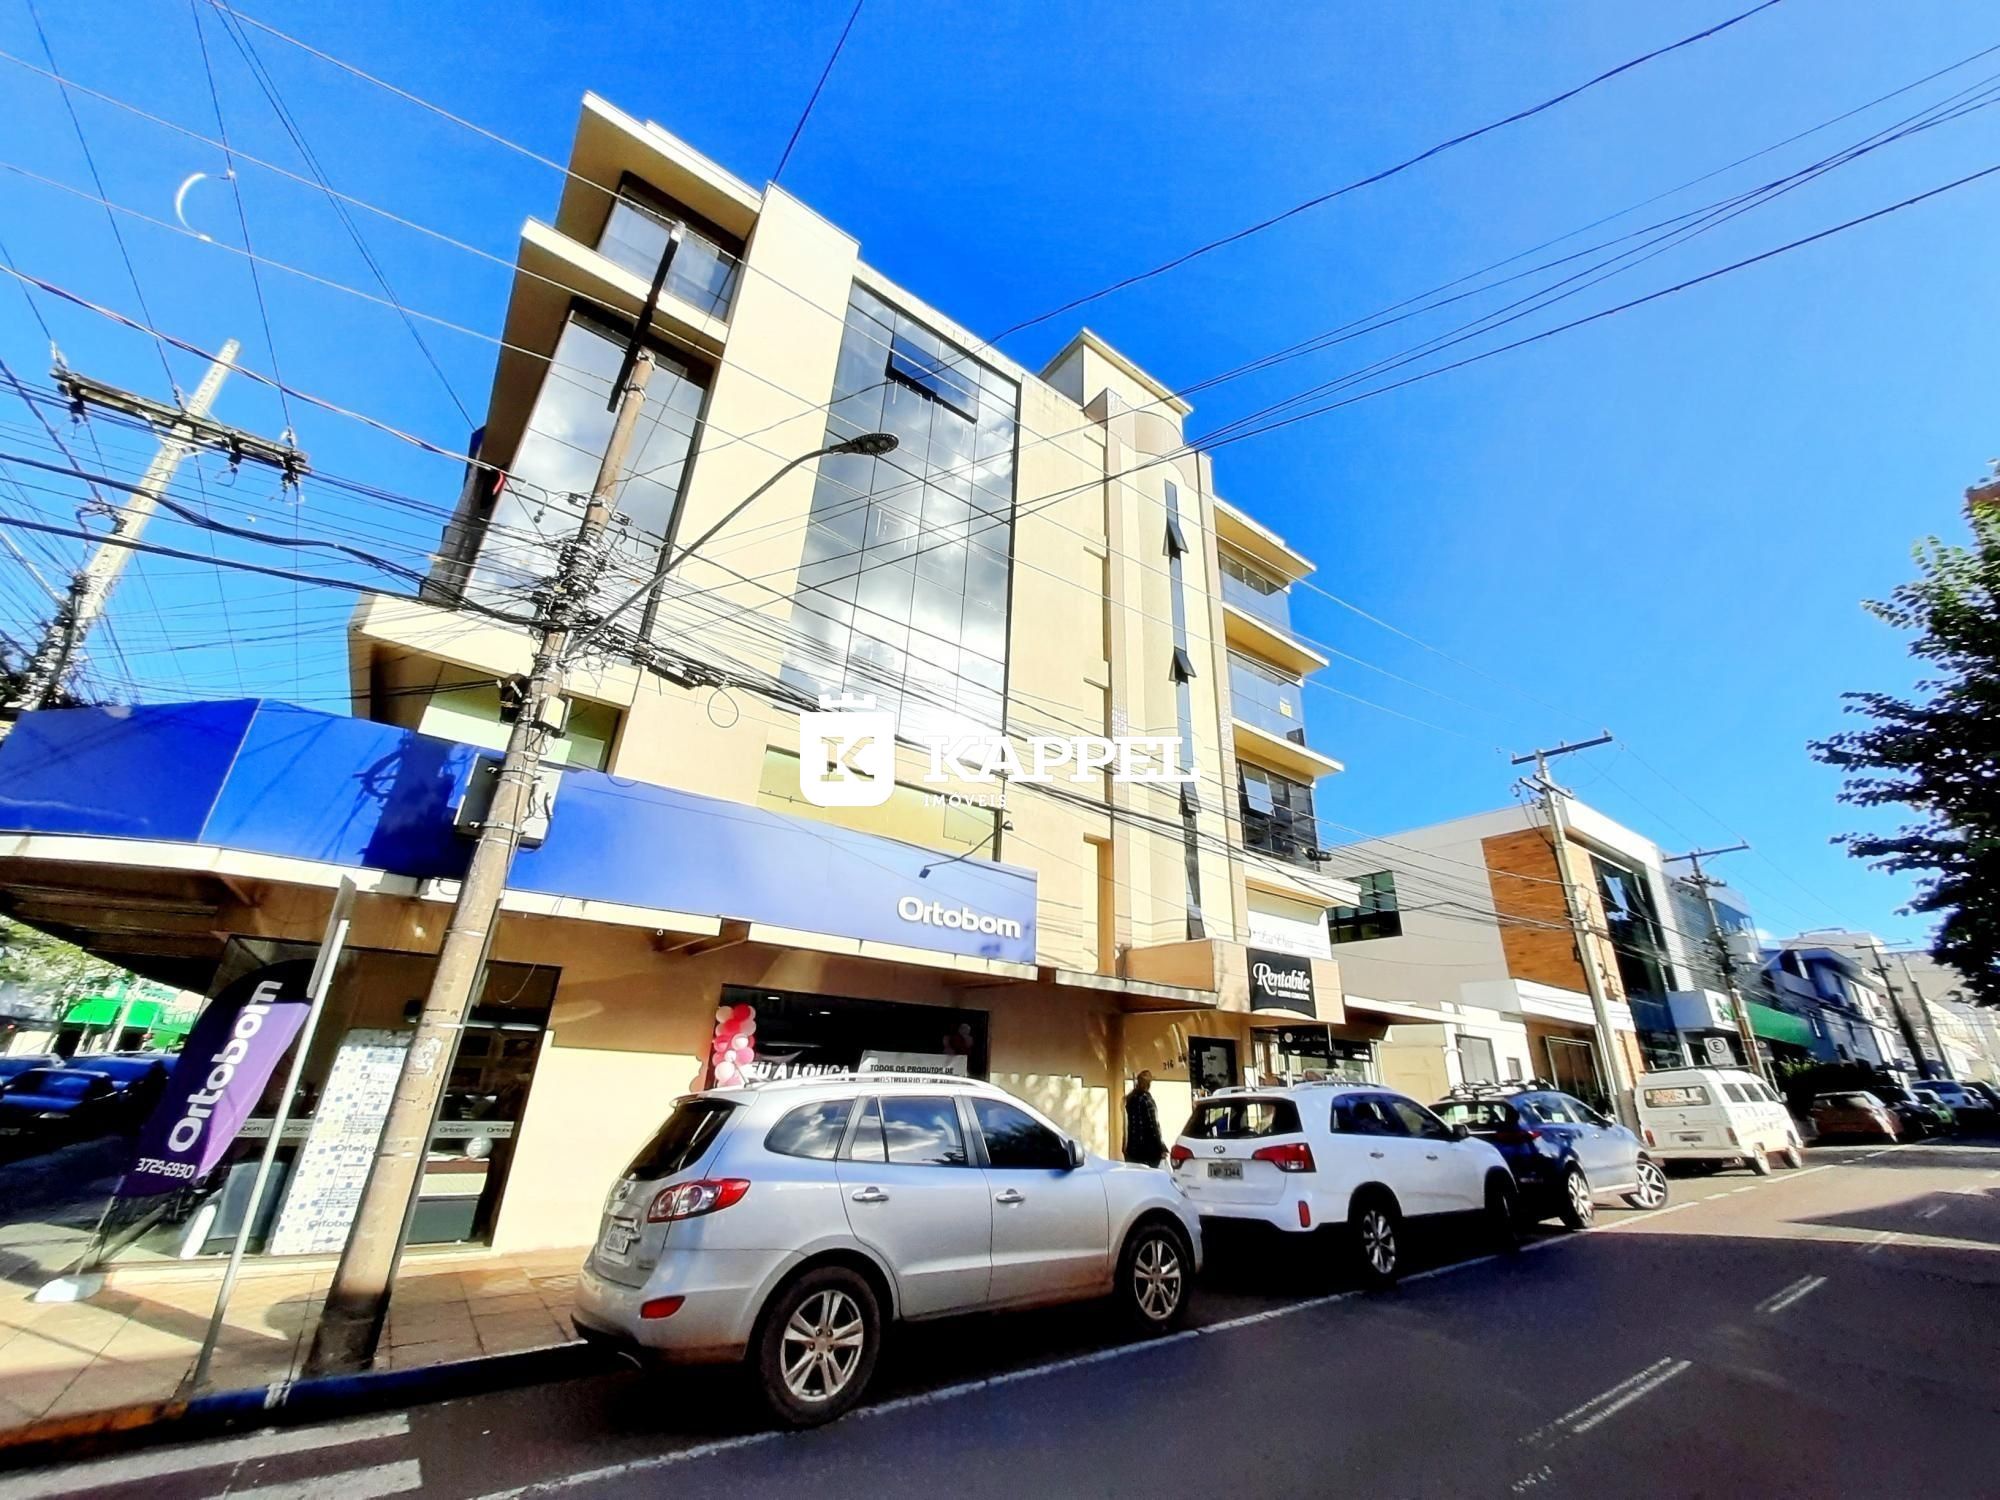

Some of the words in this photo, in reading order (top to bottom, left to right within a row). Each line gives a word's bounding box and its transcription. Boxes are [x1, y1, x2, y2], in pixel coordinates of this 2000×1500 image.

[897, 895, 1021, 939] Ortobom
[1252, 962, 1311, 996] Rentabile
[167, 980, 284, 1153] Ortobom
[870, 1064, 893, 1073] TODOS
[895, 1065, 906, 1073] OS
[906, 1065, 943, 1075] PRODUTOS
